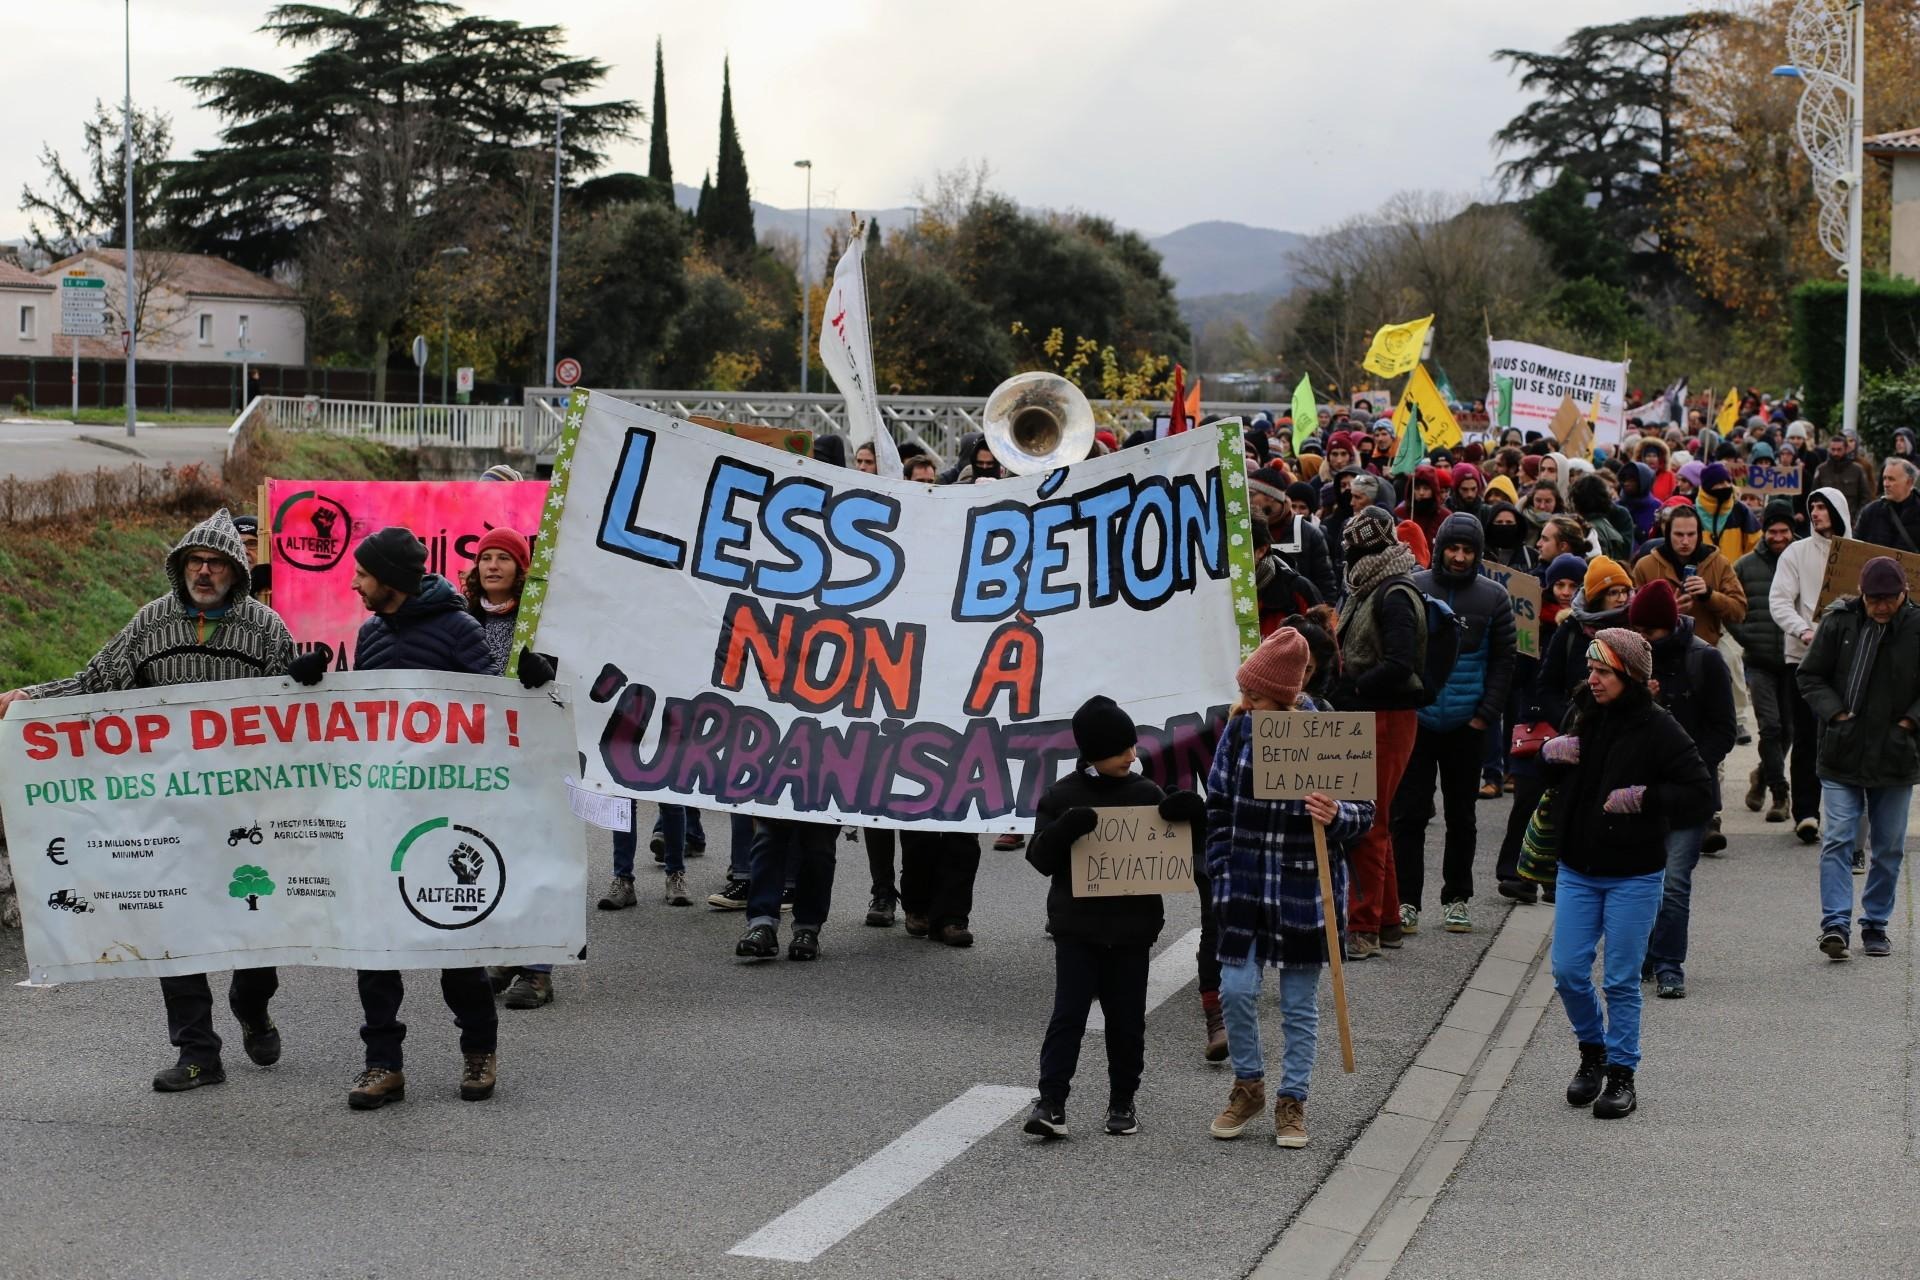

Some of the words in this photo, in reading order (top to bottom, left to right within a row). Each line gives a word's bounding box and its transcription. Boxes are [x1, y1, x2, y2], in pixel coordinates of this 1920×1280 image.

[1491, 357, 1518, 371] NOUS
[1520, 359, 1571, 384] SOMMES
[1573, 373, 1586, 388] LA
[1589, 376, 1616, 392] TERRE
[1530, 380, 1545, 394] SE
[596, 427, 906, 612] LESS
[951, 465, 1231, 622] BÉTON
[286, 536, 338, 554] ALTERRE
[710, 593, 926, 719] NON
[963, 612, 1044, 722] À
[22, 714, 171, 761] STOP
[190, 700, 486, 750] DEVIATION
[505, 709, 520, 747] !
[1259, 716, 1291, 738] QUI
[1348, 722, 1363, 736] le
[1262, 745, 1310, 762] BETON
[1316, 752, 1341, 760] aura
[24, 777, 97, 806] POUR
[105, 773, 156, 801] DES
[165, 762, 362, 797] ALTERNATIVES
[367, 760, 511, 791] CRÉDIBLES
[1265, 771, 1286, 790] LA
[1294, 773, 1344, 791] DALLE
[325, 819, 347, 828] TERRES
[1087, 817, 1139, 842] NON
[1147, 826, 1157, 841] à
[1162, 823, 1177, 839] la
[104, 839, 142, 848] MILLIONS
[144, 837, 180, 847] D'EUROS
[274, 831, 318, 840] AGRICOLES
[112, 850, 154, 859] MINIMUM
[1087, 851, 1194, 882] DÉVIATION
[287, 877, 297, 885] 26
[93, 891, 110, 900] UNE
[111, 890, 142, 900] HAUSSE
[143, 889, 156, 899] DU
[157, 887, 187, 897] TRAFIC
[286, 888, 336, 898] D'URBANISATION
[416, 887, 487, 903] ALTERRE
[119, 902, 164, 911] INEVITABLE
